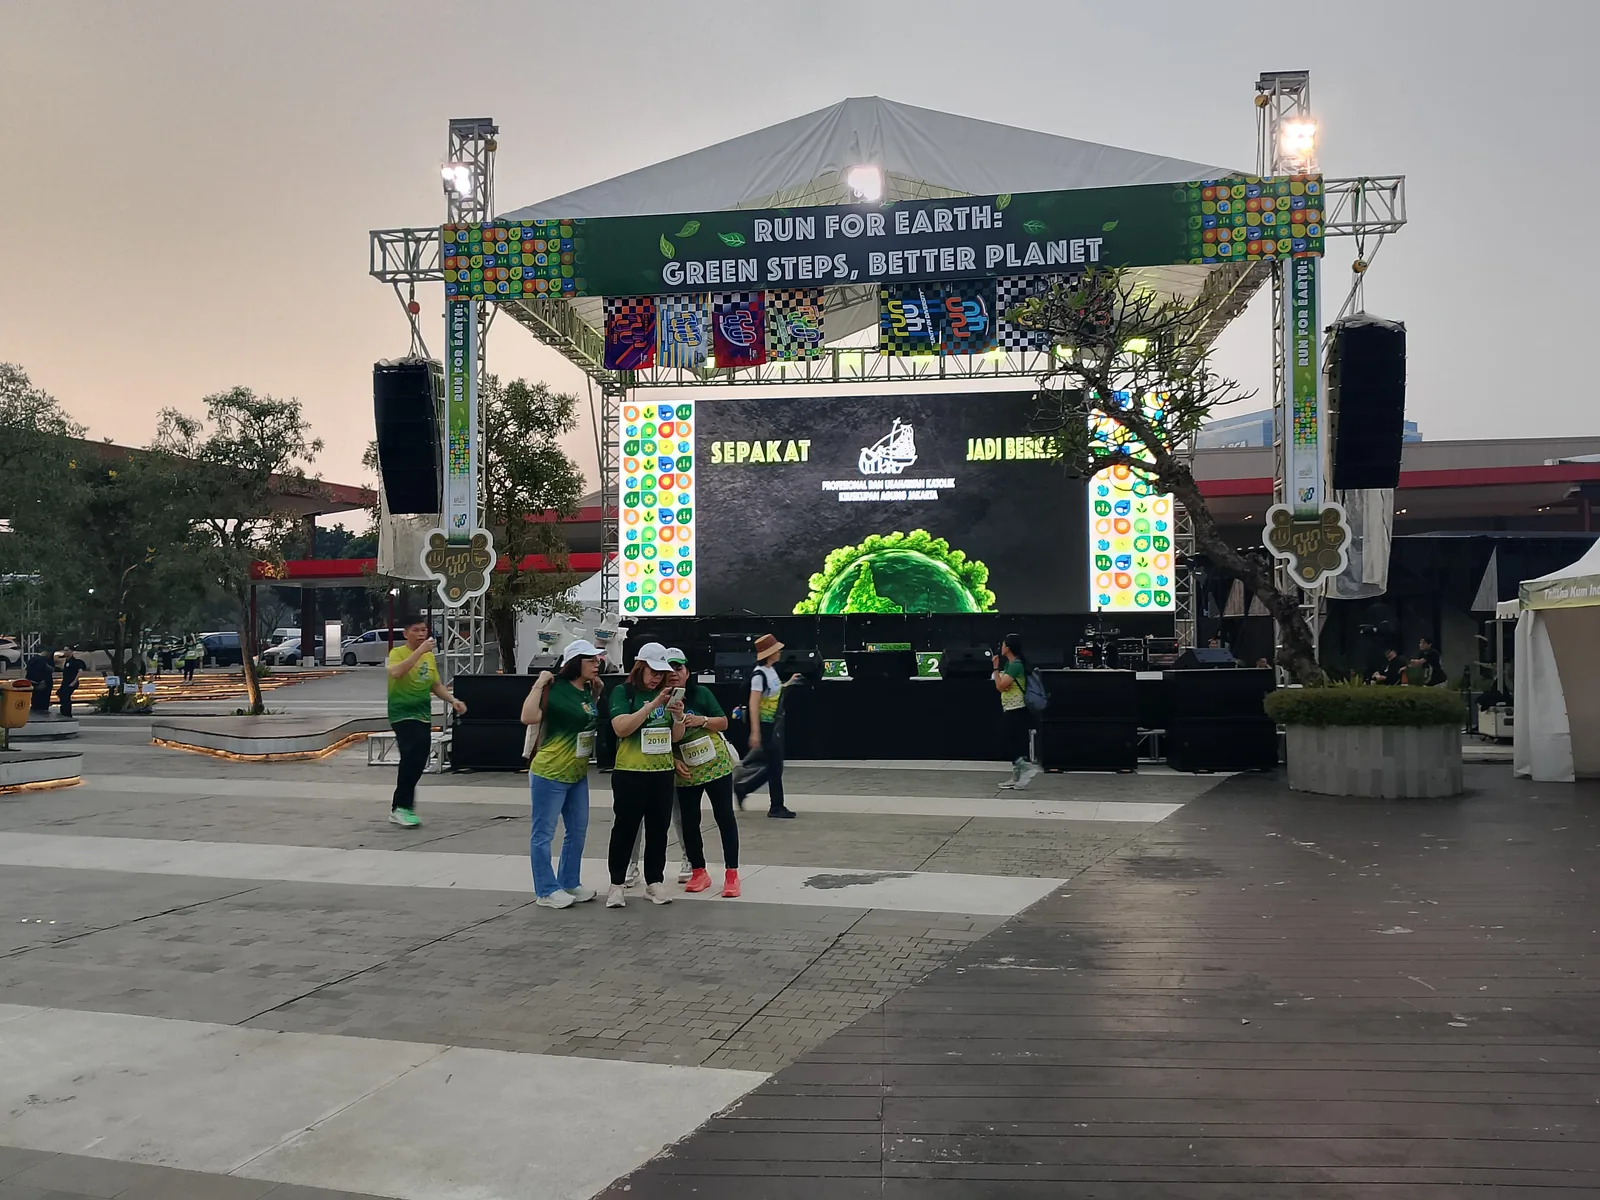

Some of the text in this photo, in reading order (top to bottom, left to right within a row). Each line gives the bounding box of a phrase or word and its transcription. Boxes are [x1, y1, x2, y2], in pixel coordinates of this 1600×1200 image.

[754, 204, 1003, 242] RUN FOR EARTH:
[662, 237, 1104, 286] GREEN STEPS, BETTER PLANET
[1297, 261, 1308, 366] RUN FOR EARTH:
[454, 304, 464, 402] RUN FOR EARTH:
[710, 438, 811, 464] SEPAKAT
[966, 438, 1002, 461] JADI
[838, 662, 849, 677] 3
[927, 658, 940, 673] 2
[688, 746, 709, 759] 20165
